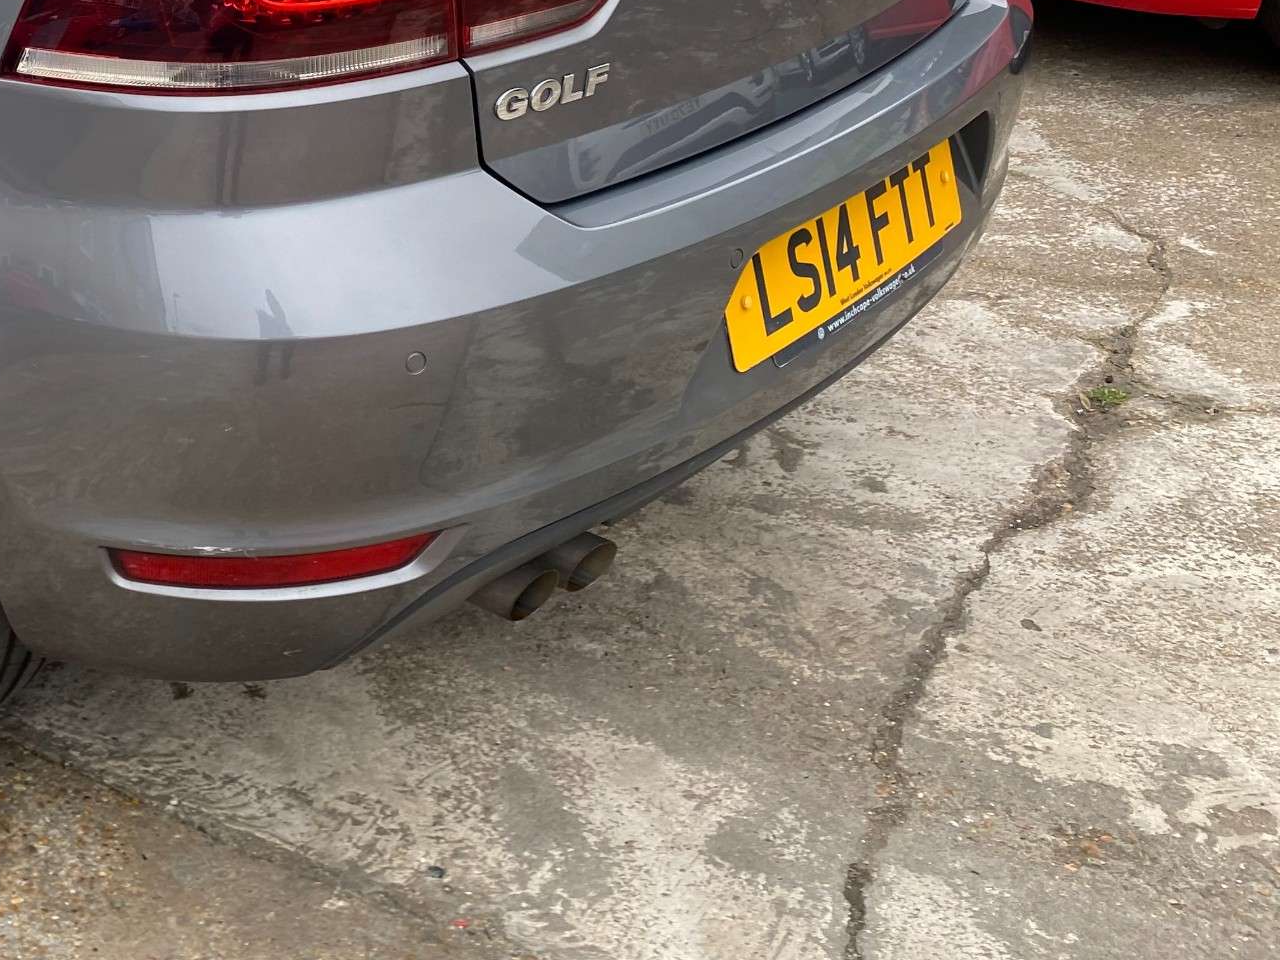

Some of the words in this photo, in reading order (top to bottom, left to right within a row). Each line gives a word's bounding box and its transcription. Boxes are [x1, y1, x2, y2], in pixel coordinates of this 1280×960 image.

[494, 62, 611, 121] GOLF
[751, 202, 861, 337] LS14
[863, 151, 935, 266] FTT
